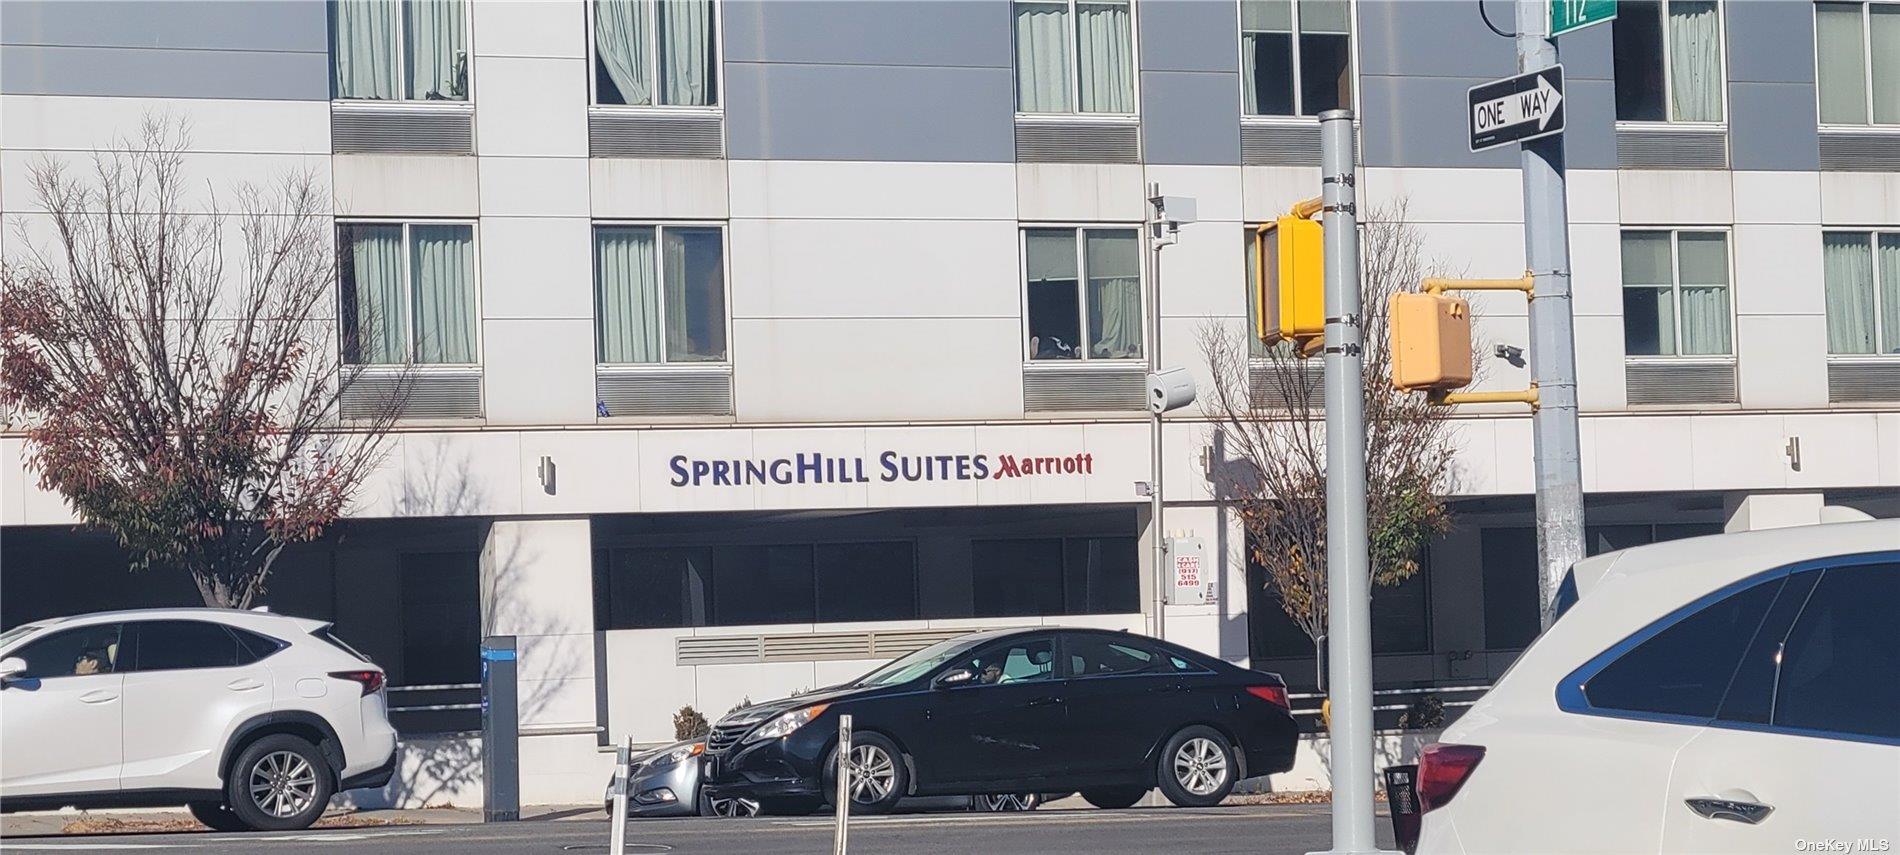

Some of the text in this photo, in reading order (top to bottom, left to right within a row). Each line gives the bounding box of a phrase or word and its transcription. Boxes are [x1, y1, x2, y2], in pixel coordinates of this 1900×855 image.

[1477, 89, 1550, 129] ONE WAY
[880, 451, 989, 482] SUITES
[993, 453, 1093, 480] Marriott
